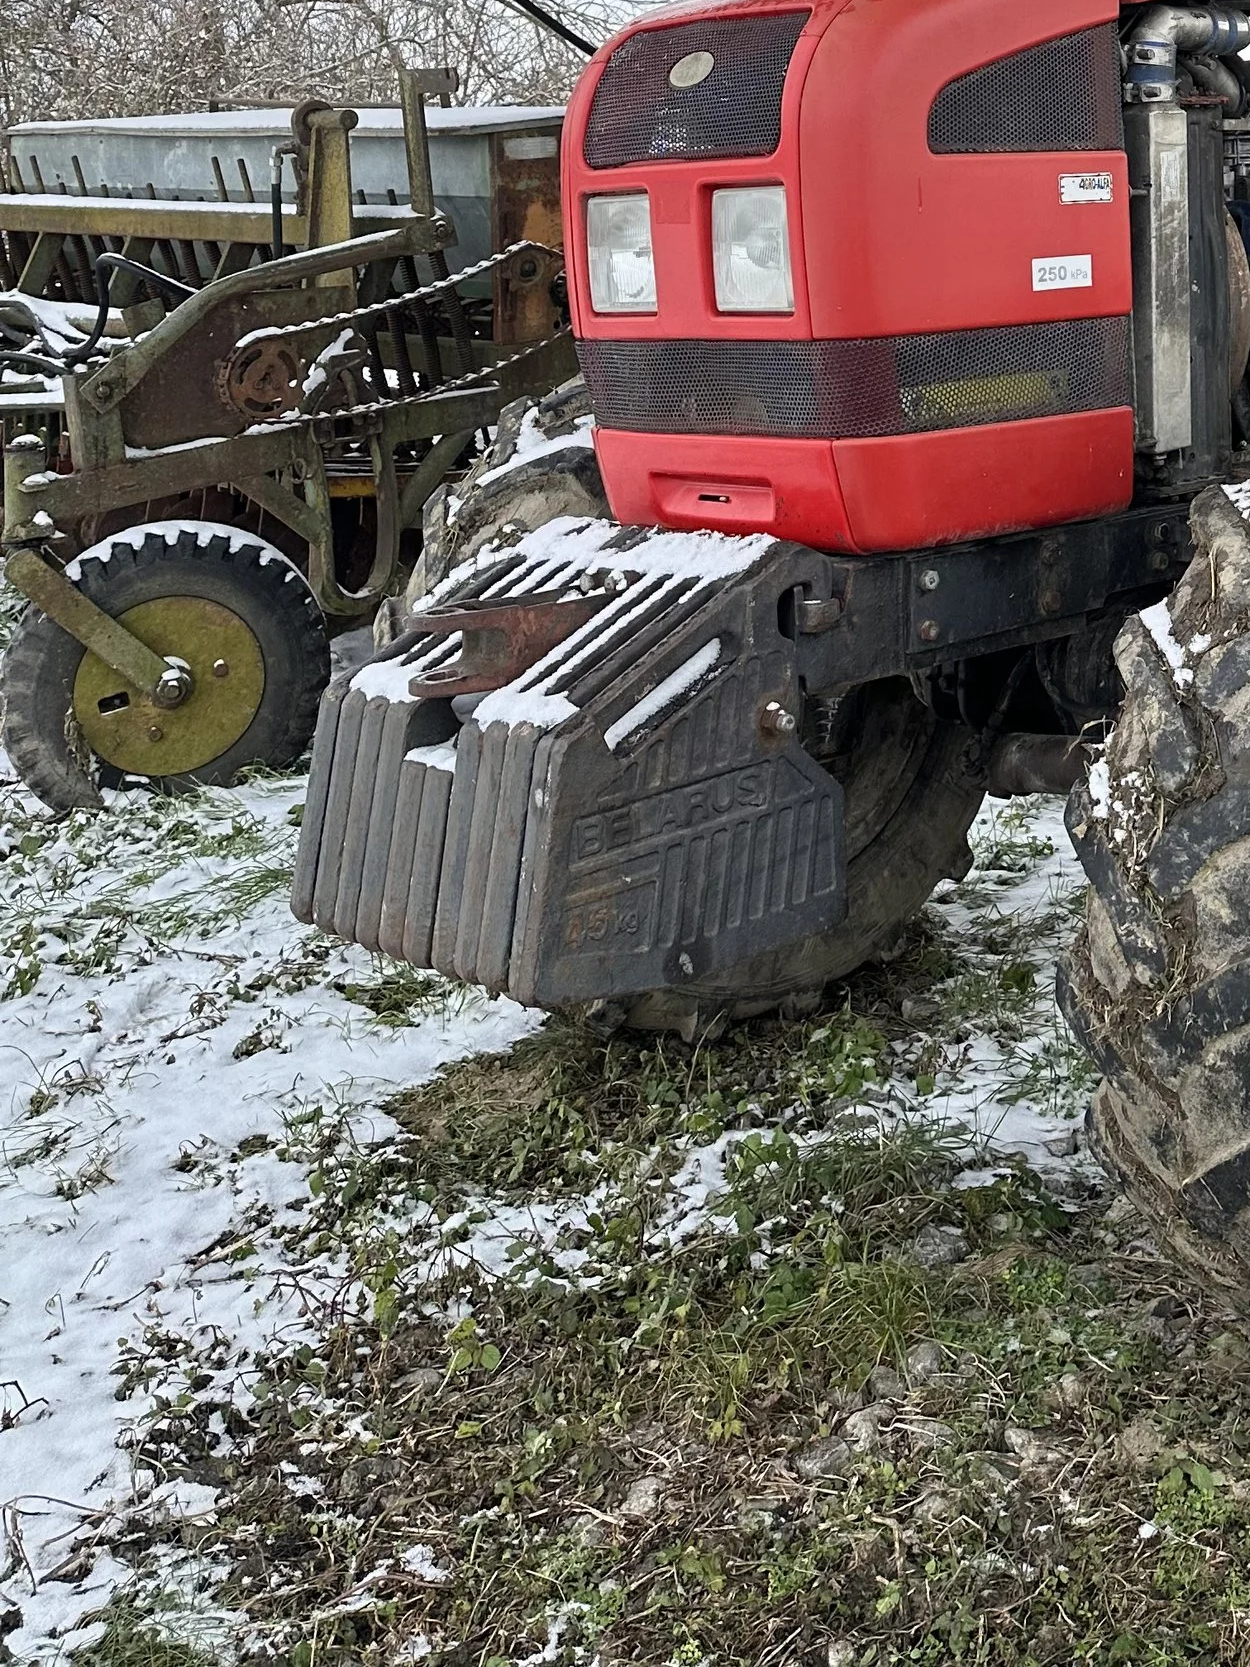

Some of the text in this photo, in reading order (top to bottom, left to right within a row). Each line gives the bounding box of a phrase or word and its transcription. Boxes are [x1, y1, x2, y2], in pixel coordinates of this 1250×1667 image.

[1037, 265, 1088, 283] 250 kPa
[577, 772, 768, 860] BELARUS
